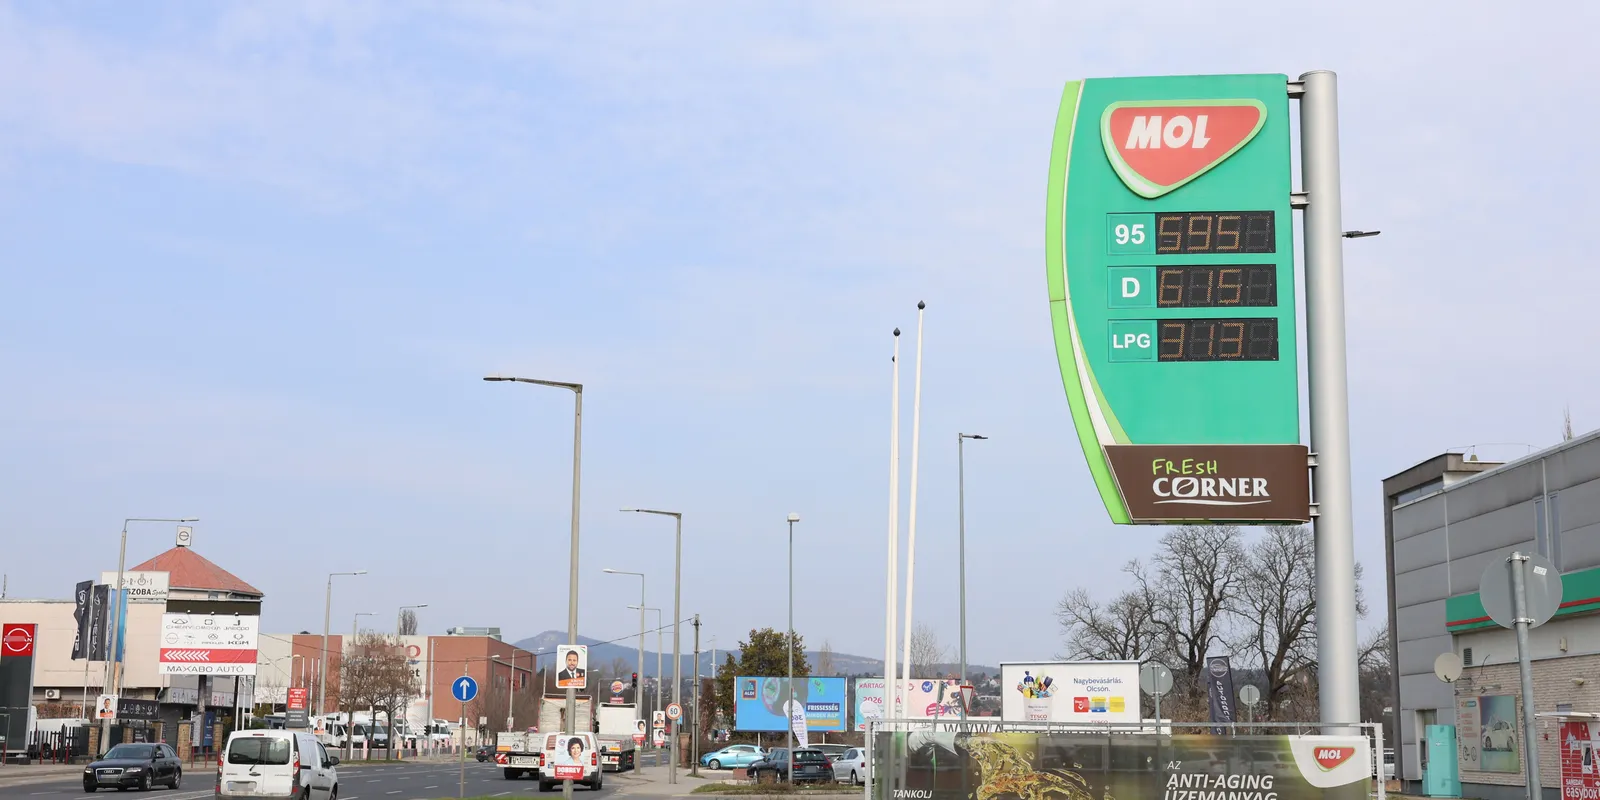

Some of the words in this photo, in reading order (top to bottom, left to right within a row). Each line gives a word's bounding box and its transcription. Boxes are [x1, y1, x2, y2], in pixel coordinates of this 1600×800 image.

[1125, 115, 1211, 149] MOL
[1114, 224, 1145, 245] 95
[1158, 216, 1242, 251] 595
[1121, 278, 1140, 298] D
[1158, 269, 1243, 305] 615
[1112, 334, 1151, 349] LPG
[1160, 322, 1245, 358] 313
[1152, 459, 1218, 475] FRESH
[1152, 477, 1270, 498] CORNER
[166, 665, 213, 673] MAXABO
[216, 664, 244, 673] AUTÓ
[1073, 677, 1124, 685] Nagybevásárlás.
[807, 703, 839, 711] FRISSESSÉG
[1318, 749, 1342, 760] MOL
[1167, 760, 1182, 770] AZ
[1167, 774, 1274, 789] ANTI-AGING
[893, 789, 933, 799] TANKOLJ
[1164, 787, 1278, 800] ÜZEMANYAG
[1565, 784, 1598, 800] easybox
